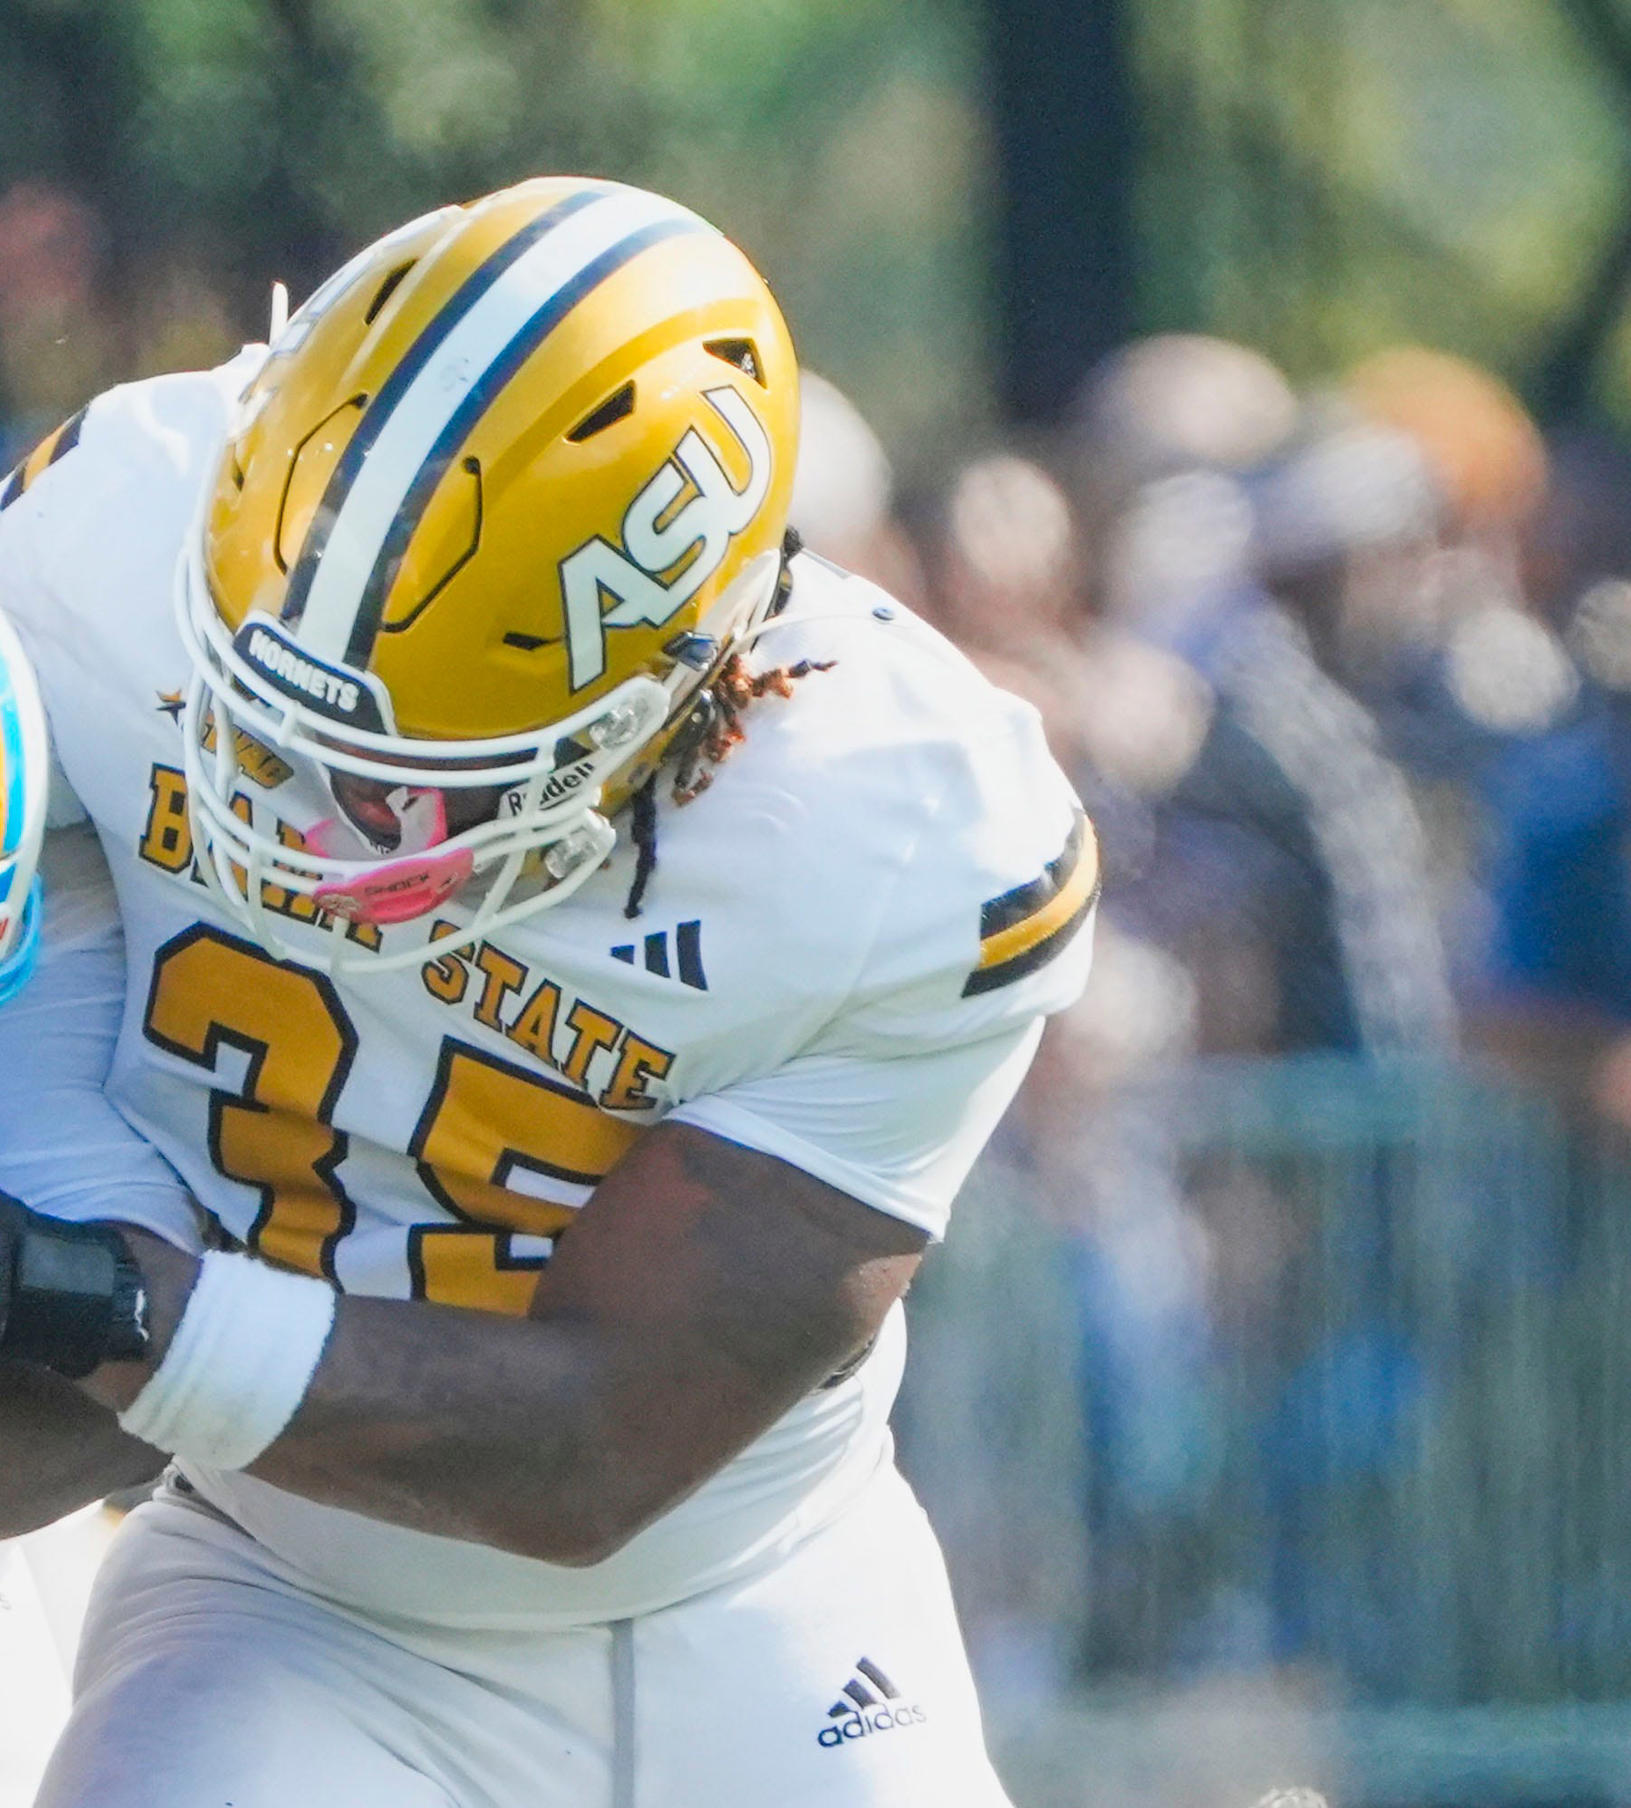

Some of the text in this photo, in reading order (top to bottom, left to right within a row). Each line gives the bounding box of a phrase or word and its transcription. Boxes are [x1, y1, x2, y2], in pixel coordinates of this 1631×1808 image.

[557, 384, 772, 692] ASU
[249, 630, 360, 712] HORNETS
[421, 918, 676, 1110] STATE
[143, 920, 658, 1318] 35
[818, 1703, 927, 1748] adidas
